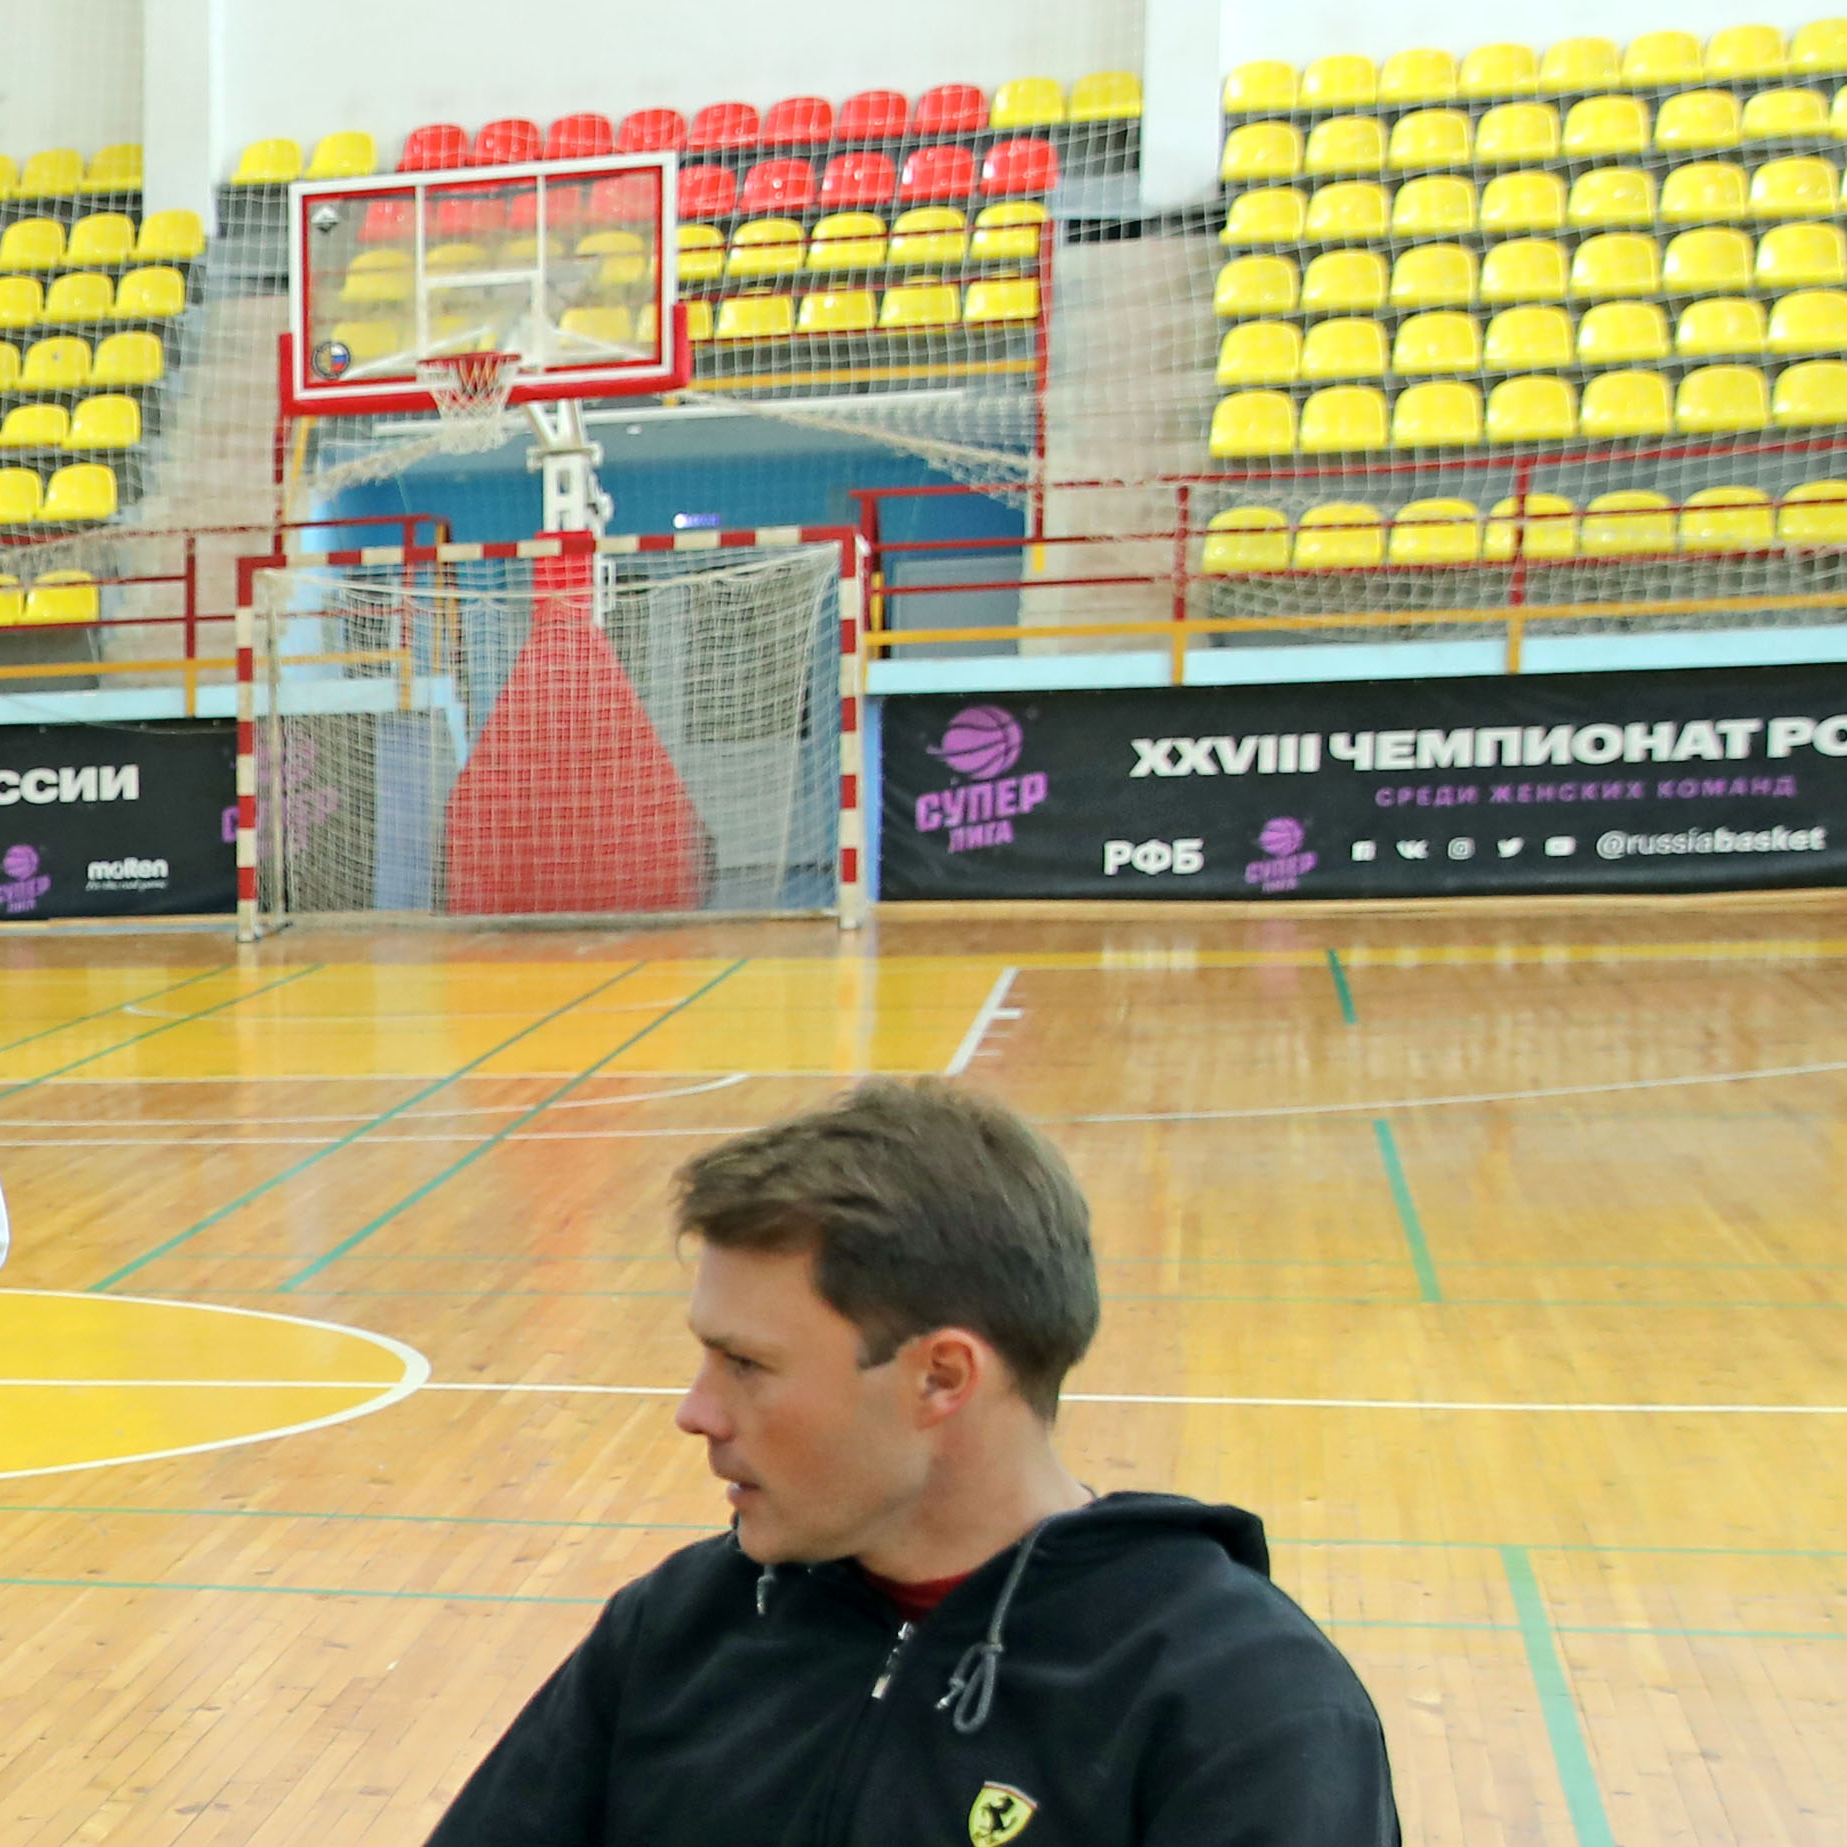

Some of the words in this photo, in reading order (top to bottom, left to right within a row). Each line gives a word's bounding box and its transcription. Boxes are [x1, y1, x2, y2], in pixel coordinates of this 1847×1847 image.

[1129, 732, 1322, 778] XXVIII
[1329, 717, 1762, 771] ЧЕМПИОНАТ
[915, 772, 1048, 832] СУПЕР
[1375, 785, 1479, 807] СРЕДИ
[1490, 780, 1644, 803] ЖЕНСКИХ
[1658, 775, 1798, 798] КОМАНД
[948, 819, 1014, 853] ЛИГА
[1596, 824, 1826, 860] @russiabasket
[87, 857, 169, 880] molten
[1104, 838, 1205, 876] РФБ
